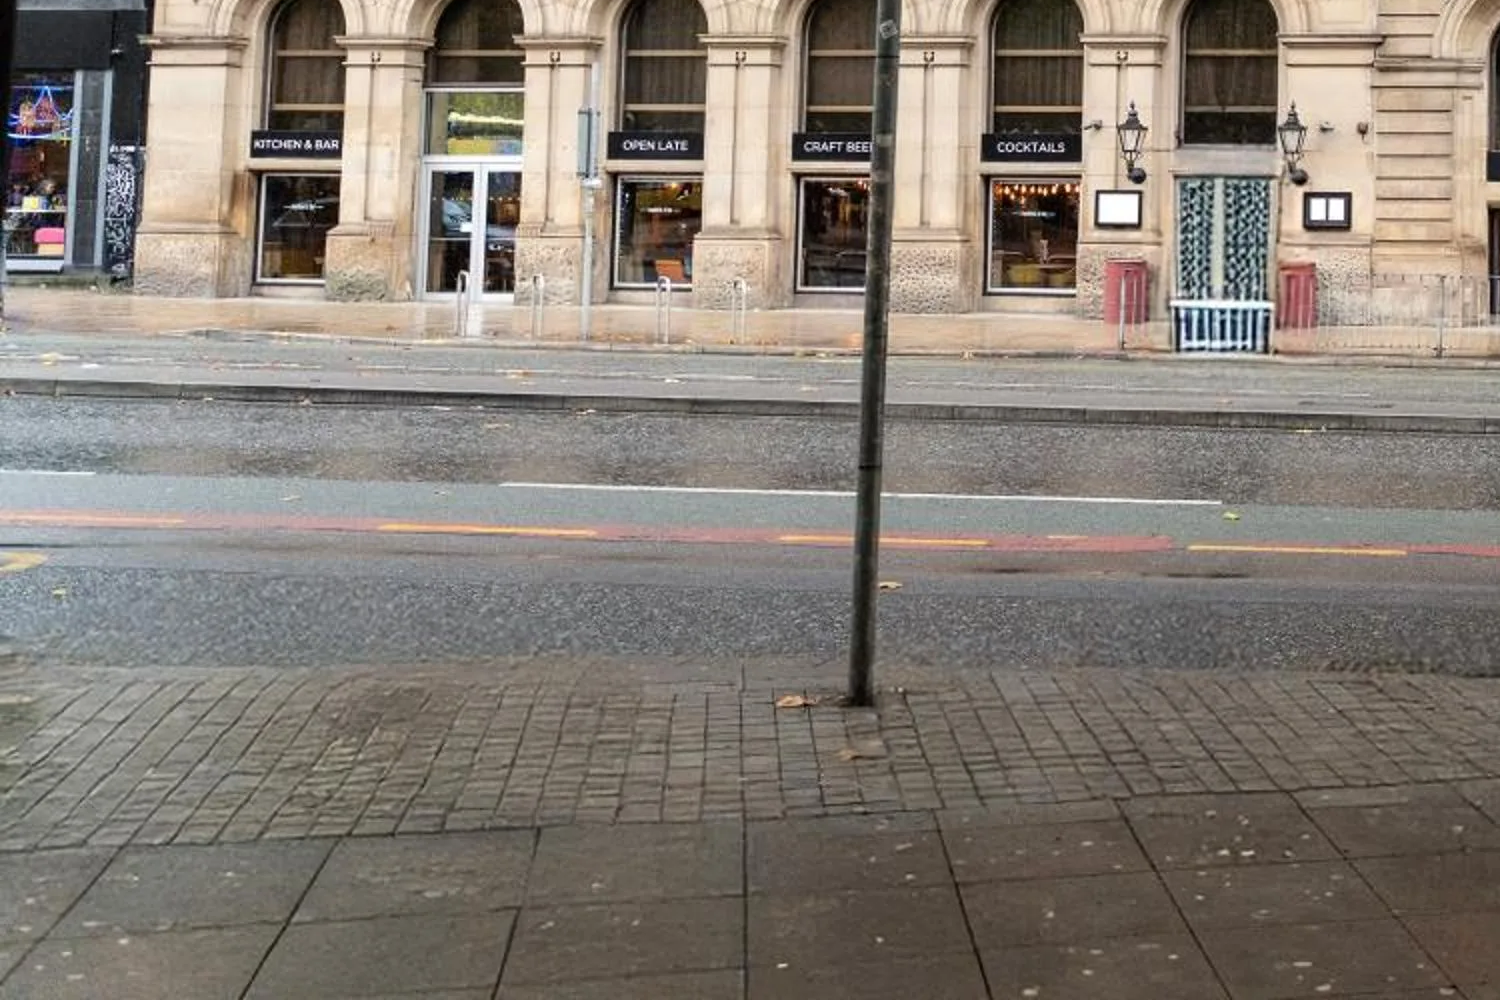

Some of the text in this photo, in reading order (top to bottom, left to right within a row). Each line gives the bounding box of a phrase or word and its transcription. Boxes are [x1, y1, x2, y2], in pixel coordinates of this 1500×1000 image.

[253, 139, 340, 150] KITCHEN & BAR
[623, 139, 689, 151] OPEN LATE
[803, 141, 844, 153] CRAFT
[996, 141, 1066, 153] COCKTAILS
